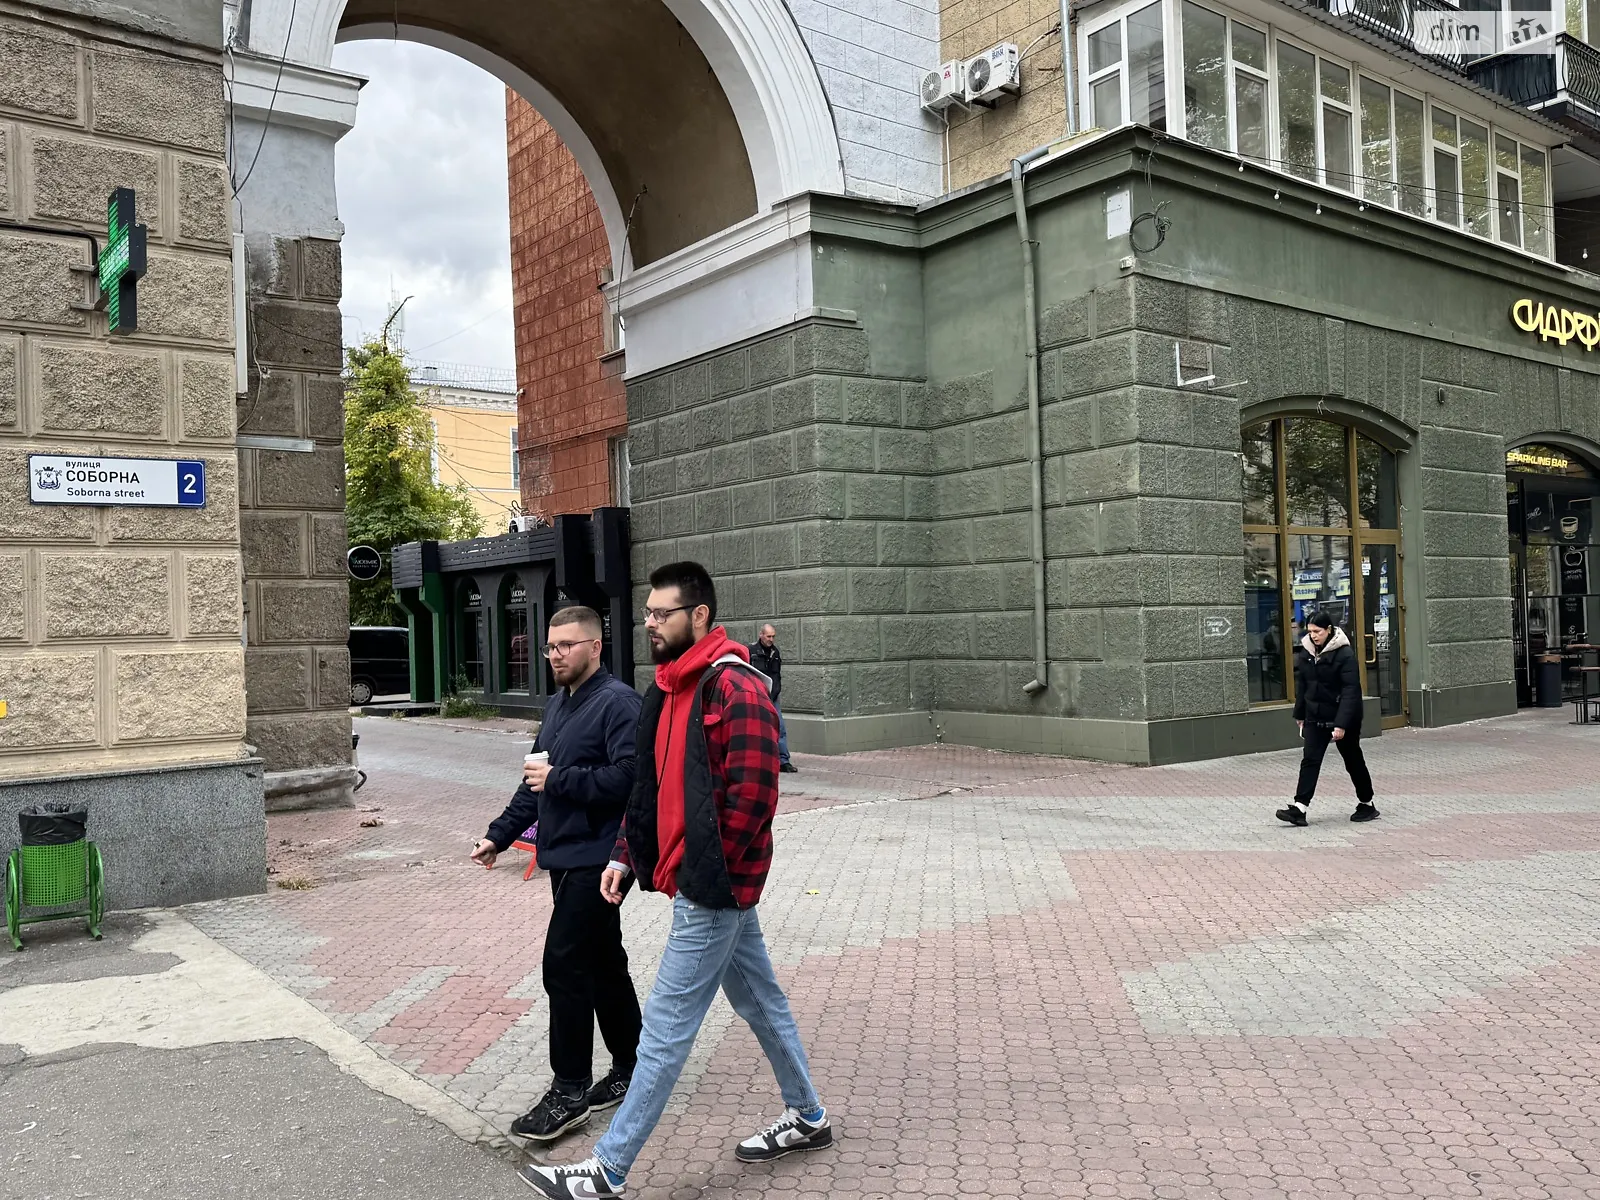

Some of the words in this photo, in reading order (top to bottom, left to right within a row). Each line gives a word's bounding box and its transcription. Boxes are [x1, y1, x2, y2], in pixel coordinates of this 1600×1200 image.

[65, 460, 101, 469] вулиця
[1506, 452, 1551, 467] SPARKLING
[1551, 458, 1568, 469] BAR
[66, 470, 140, 484] СОБОРНА
[183, 473, 197, 494] 2
[67, 487, 111, 497] Soborna
[114, 488, 145, 498] street
